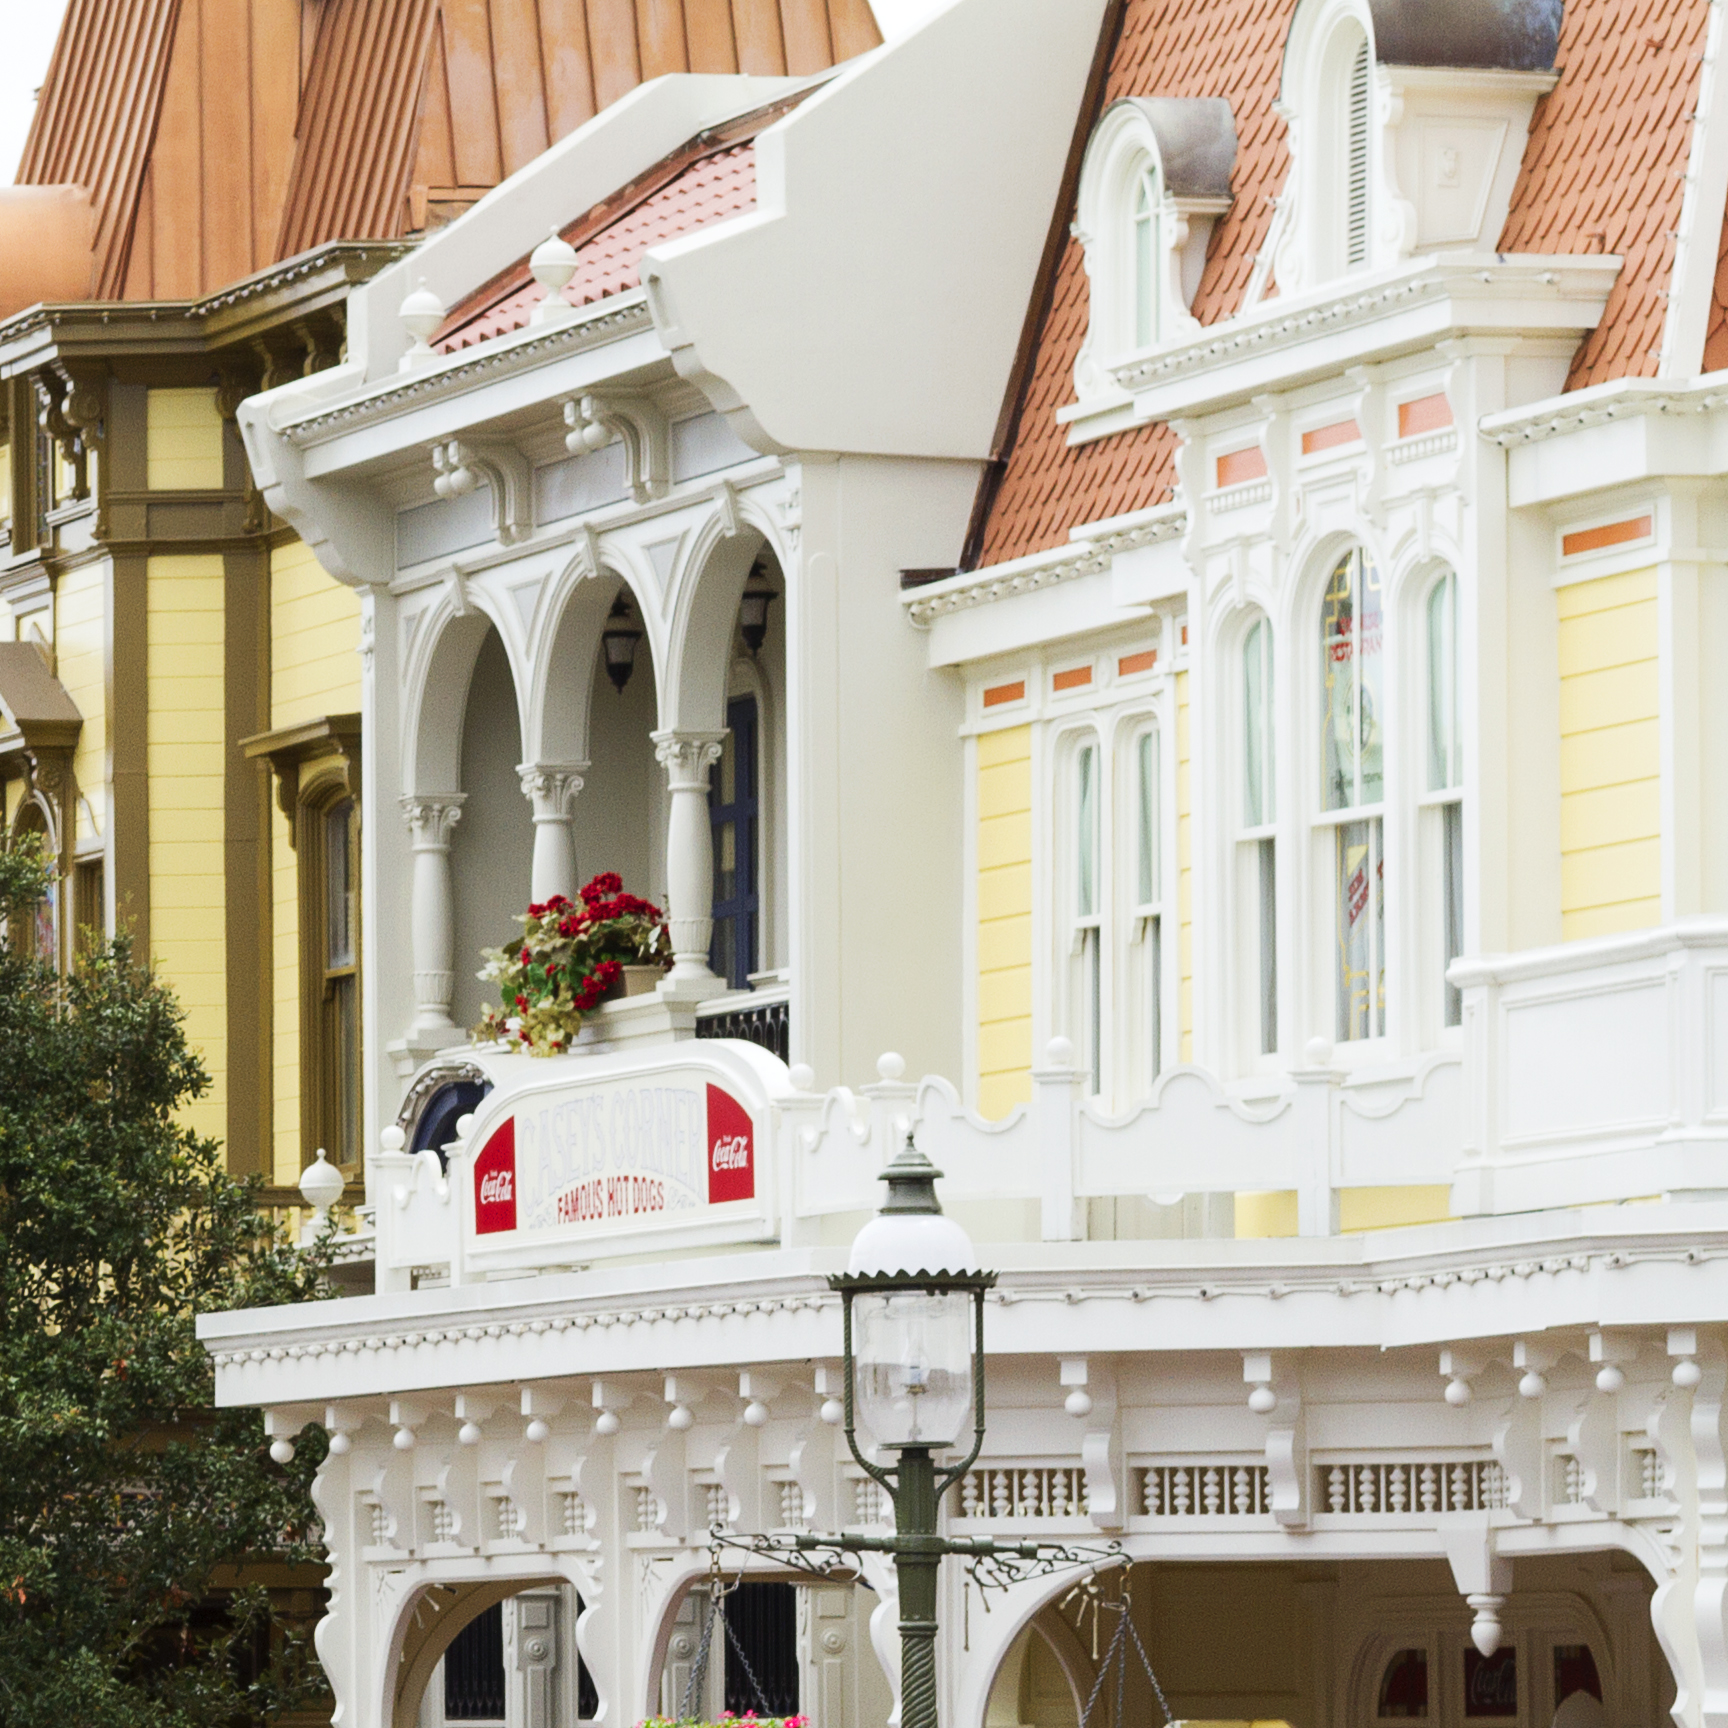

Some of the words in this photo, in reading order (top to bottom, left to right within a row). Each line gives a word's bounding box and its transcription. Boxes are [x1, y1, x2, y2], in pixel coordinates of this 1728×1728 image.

[519, 1093, 607, 1216] CASEY'S
[611, 1088, 706, 1205] CORNER
[712, 1136, 749, 1172] Coca-Cola
[480, 1171, 513, 1205] Coca-Cola
[557, 1179, 604, 1224] FAMOUS
[607, 1176, 630, 1217] HOT
[633, 1177, 664, 1214] DOGS
